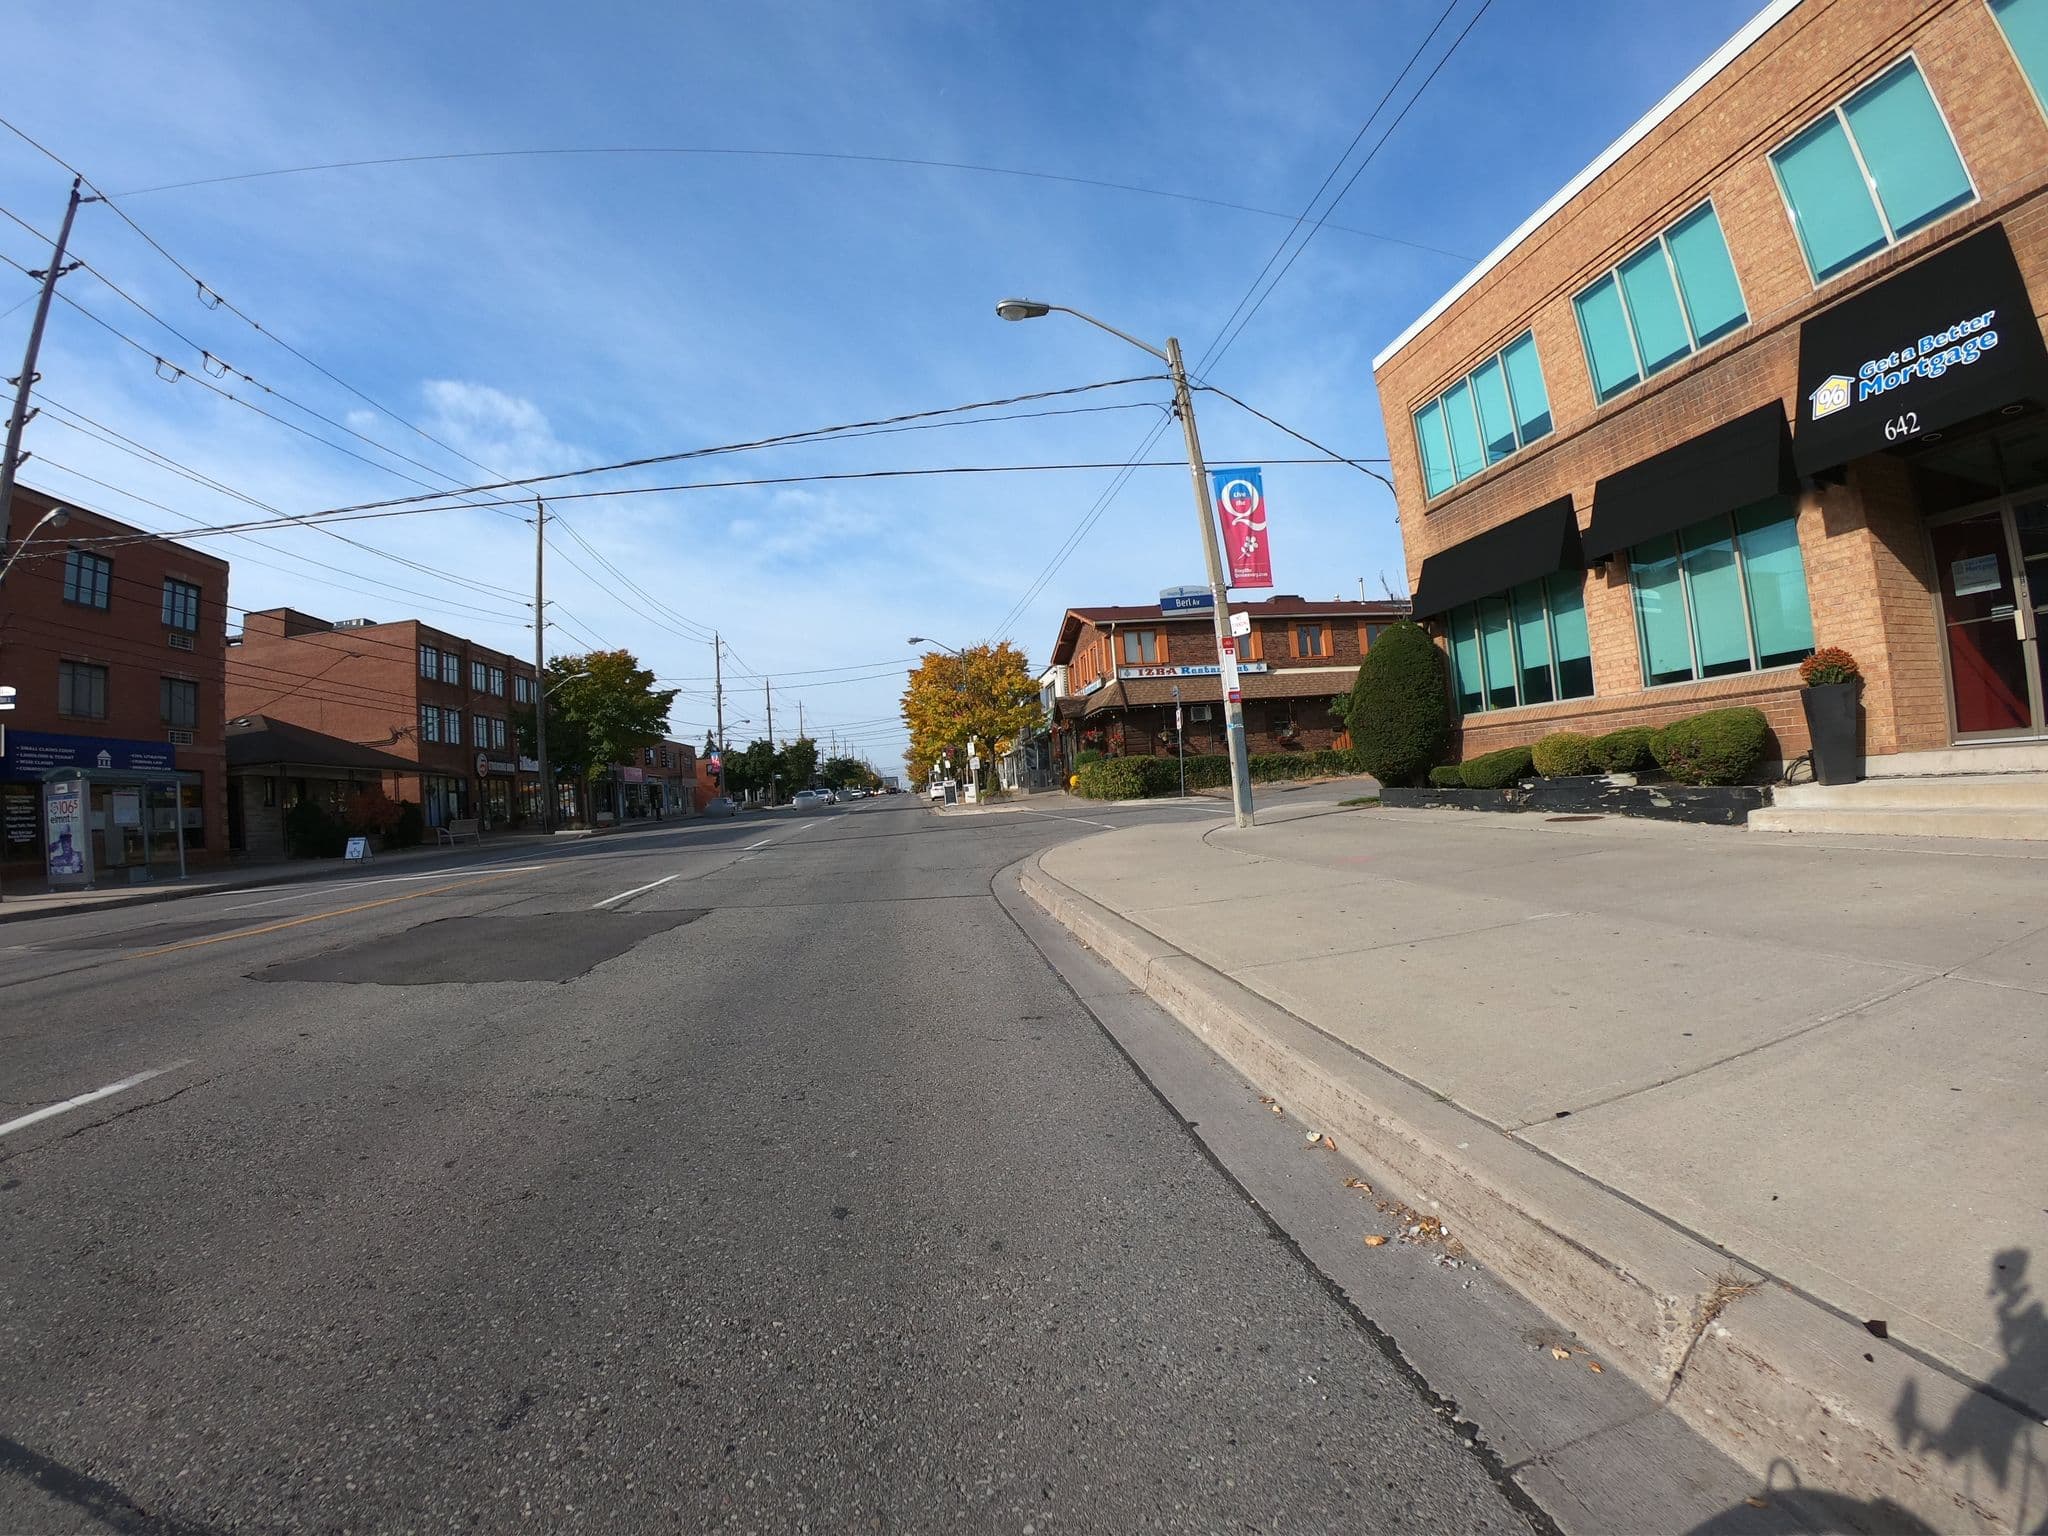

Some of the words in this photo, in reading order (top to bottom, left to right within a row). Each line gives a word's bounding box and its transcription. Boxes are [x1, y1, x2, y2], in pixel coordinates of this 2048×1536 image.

[1858, 330, 1998, 402] Mortgage
[1859, 353, 1899, 380] Get
[1901, 346, 1916, 363] a
[1917, 310, 1996, 356] Better
[1884, 411, 1921, 441] 642
[1221, 479, 1267, 531] Q
